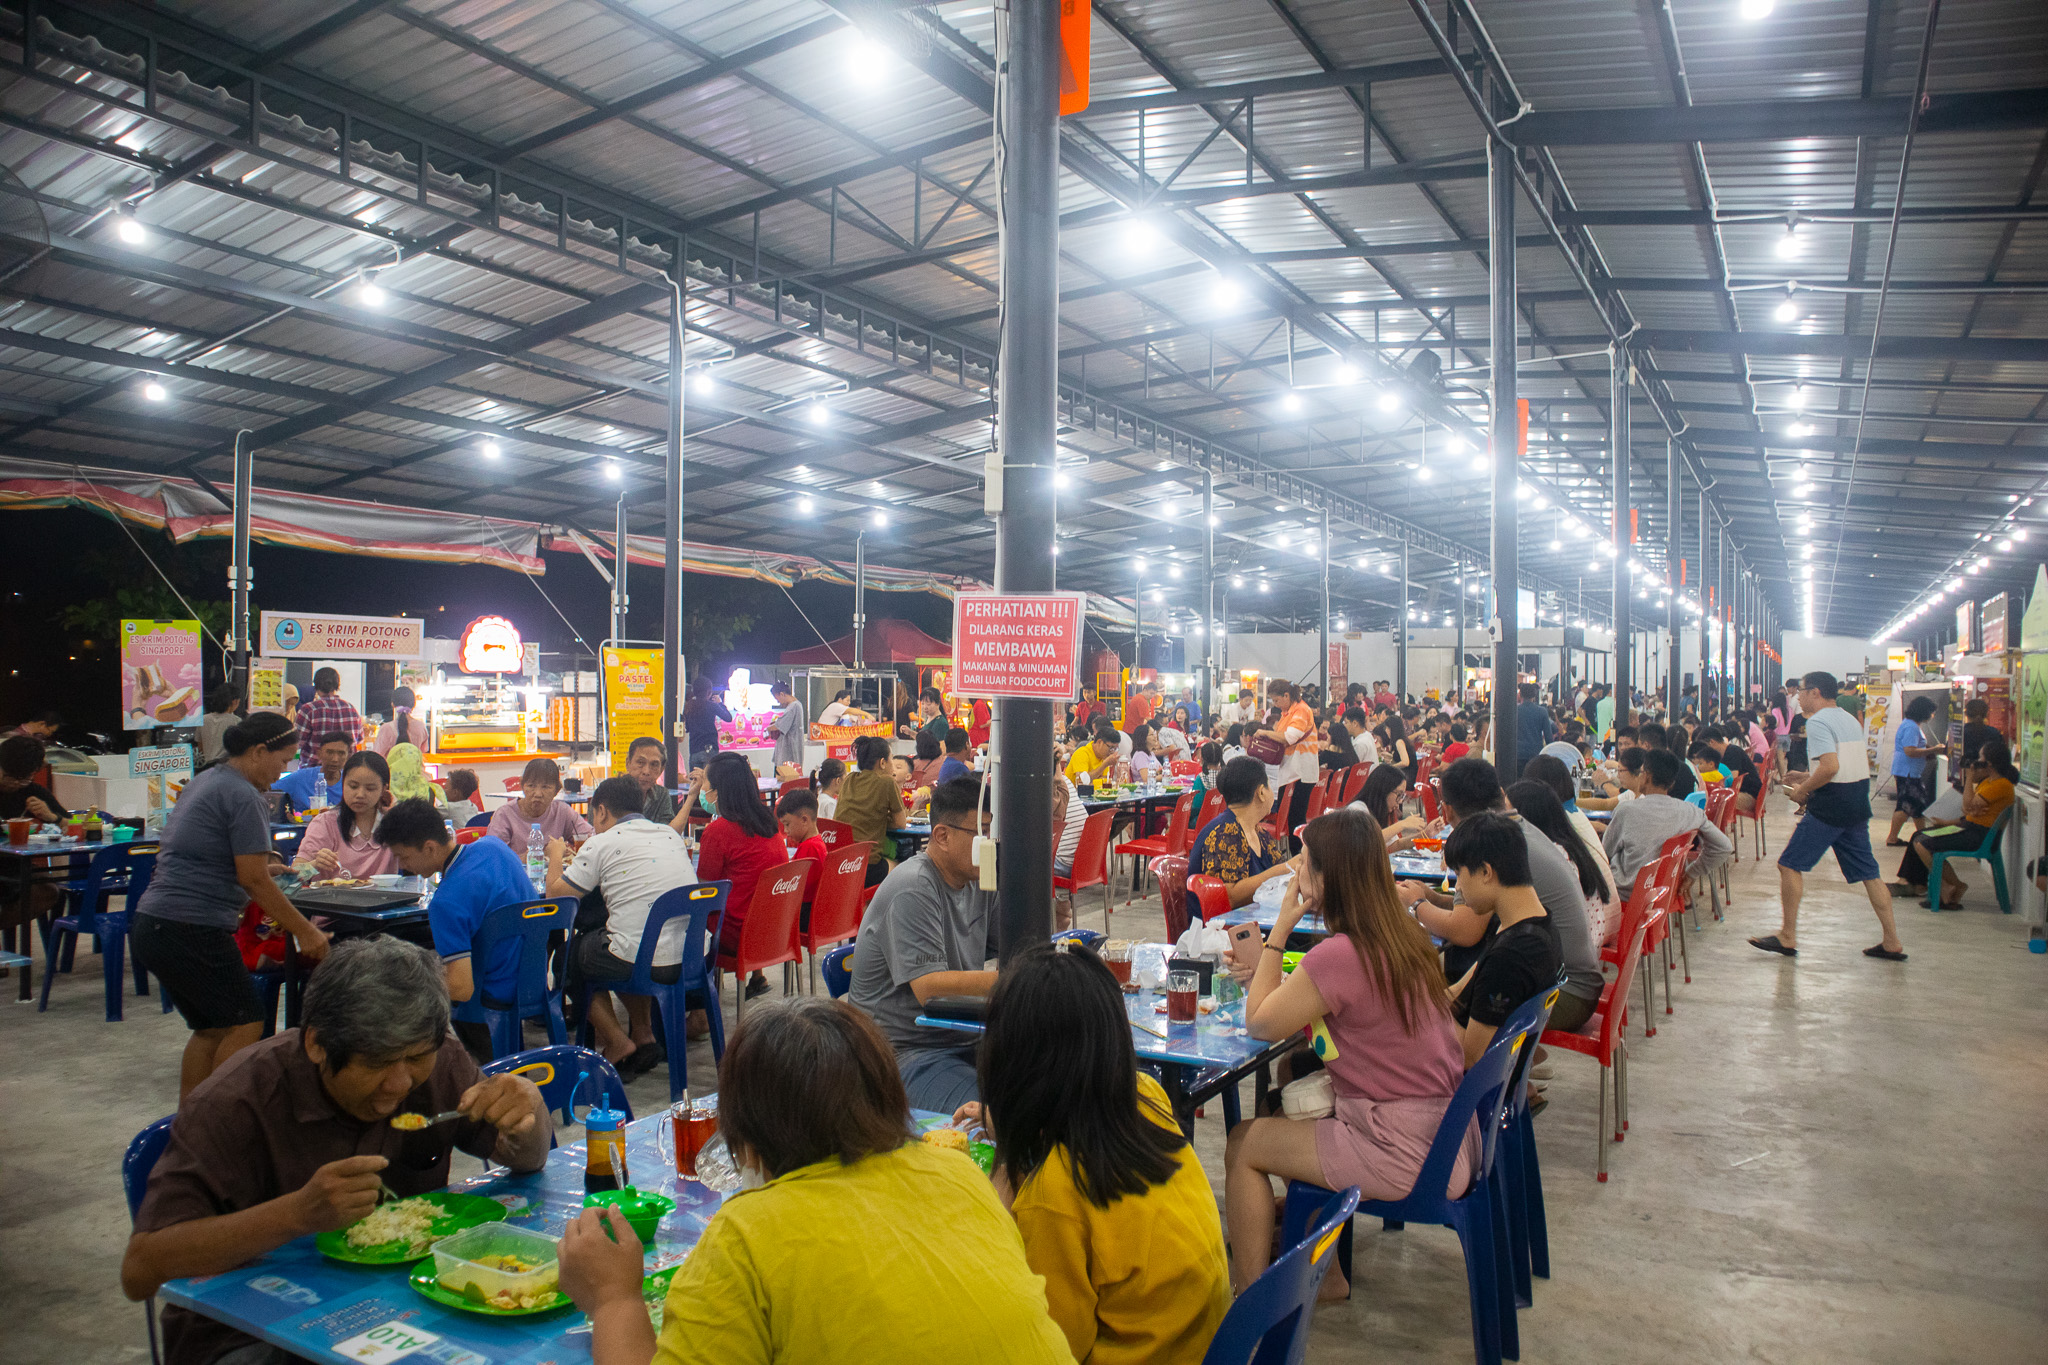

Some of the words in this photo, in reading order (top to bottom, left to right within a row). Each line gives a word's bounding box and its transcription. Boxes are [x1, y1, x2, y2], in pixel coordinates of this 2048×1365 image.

[966, 602, 1046, 618] PERHATIAN
[1052, 602, 1069, 618] !!!
[309, 623, 323, 634] ES
[327, 625, 357, 635] KRIM
[361, 626, 411, 637] POTONG
[969, 624, 1024, 636] DILARANG
[1027, 625, 1064, 637] KERAS
[130, 635, 140, 644] ES
[142, 635, 161, 644] KRIM
[165, 635, 194, 644] POTONG
[326, 637, 395, 650] SINGAPORE
[140, 646, 185, 655] SINGAPORE
[974, 642, 1056, 658] MEMBAWA
[962, 661, 1007, 672] MAKANAN
[1008, 662, 1016, 672] &
[1018, 663, 1068, 674] MINUMAN
[618, 675, 655, 684] PASTEL
[963, 674, 983, 684] DARI
[985, 675, 1007, 685] LUAR
[1008, 676, 1066, 688] FOODCOURT
[138, 750, 160, 759] ESKRIM
[161, 747, 186, 758] POTONG
[134, 757, 190, 773] SINGAPORE
[366, 1327, 427, 1351] A10
